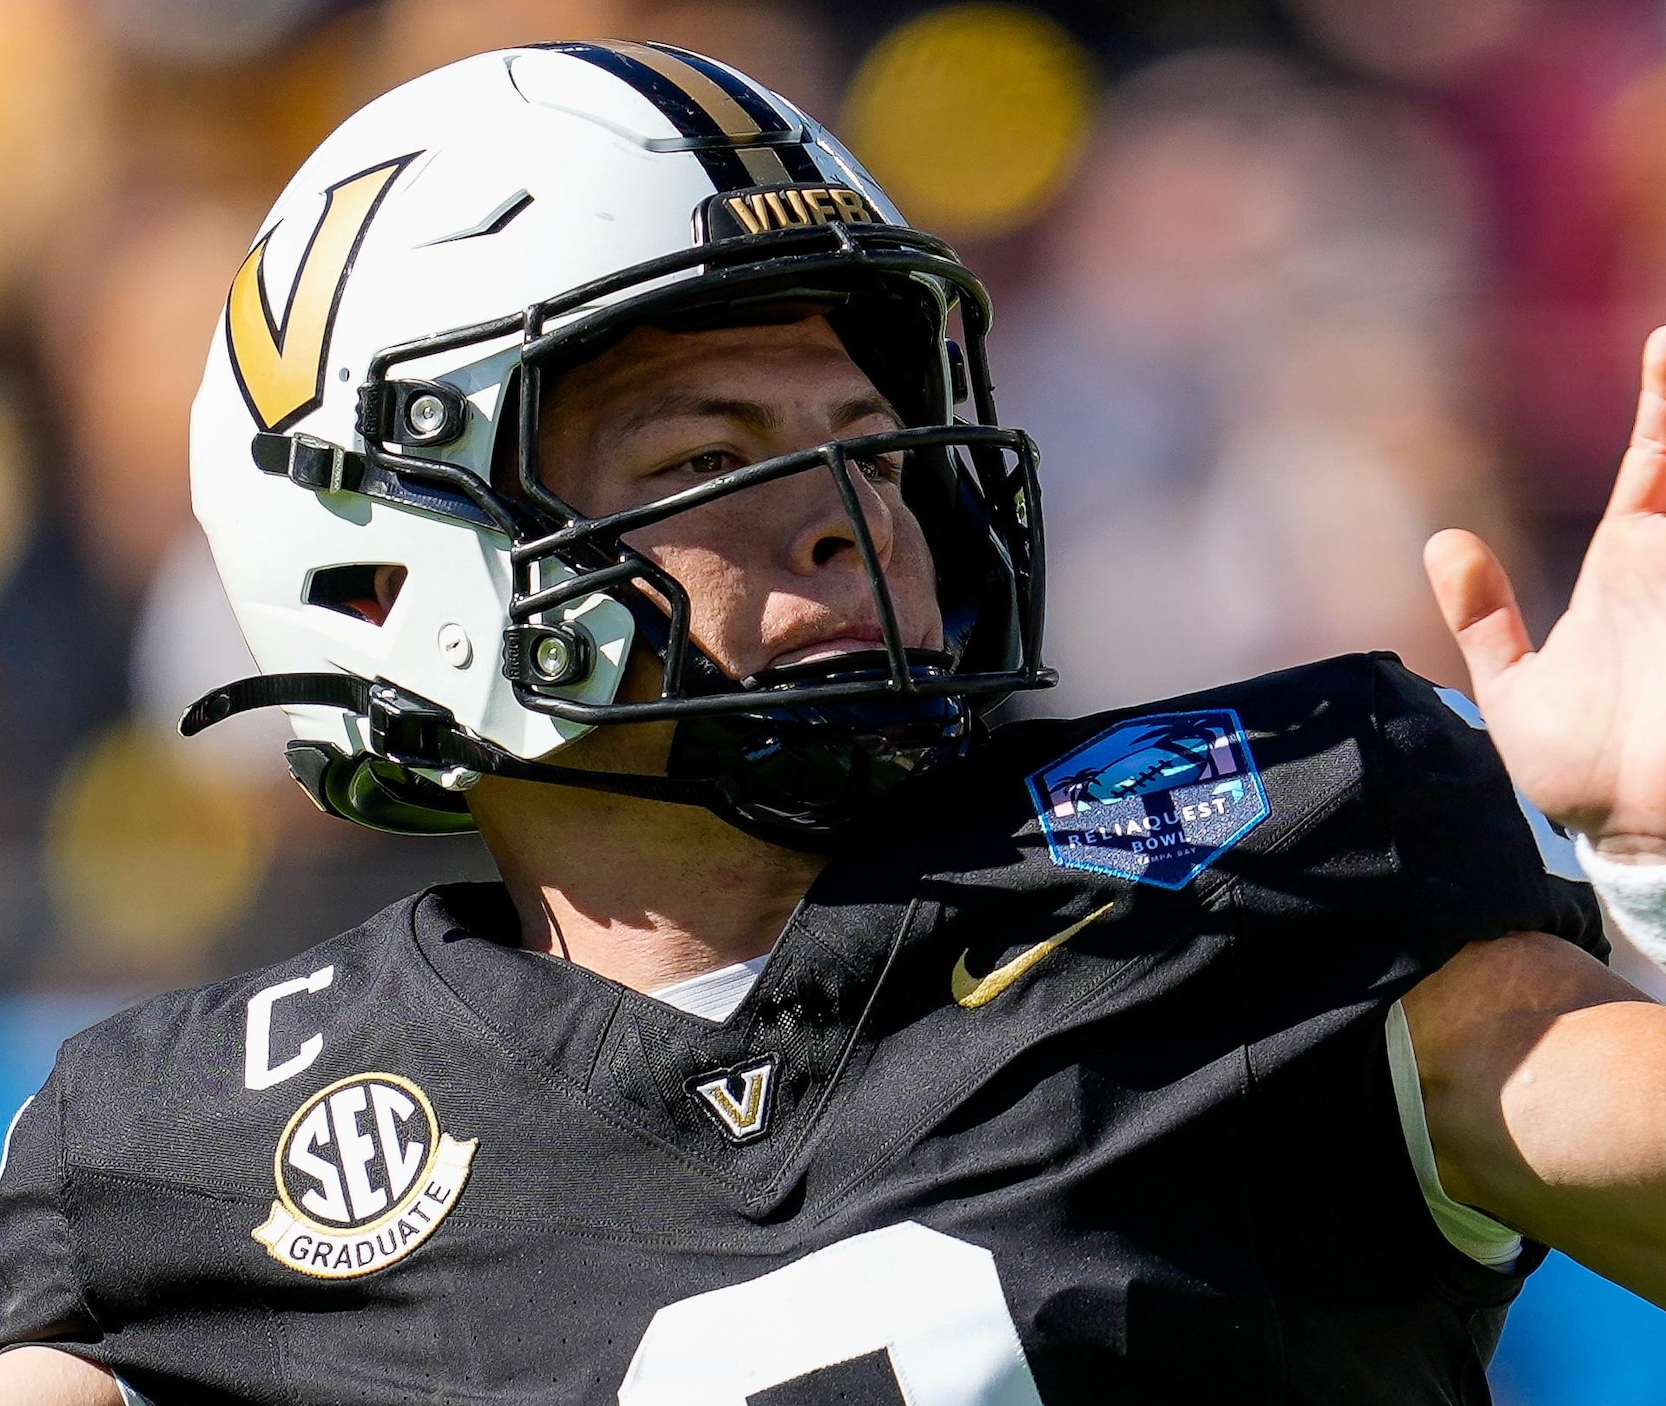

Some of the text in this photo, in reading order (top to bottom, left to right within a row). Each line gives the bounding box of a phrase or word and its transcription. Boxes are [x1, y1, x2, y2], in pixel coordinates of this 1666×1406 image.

[723, 188, 872, 235] VUFB
[225, 149, 426, 432] V
[1068, 797, 1227, 849] RELIAQUEST
[1131, 831, 1192, 853] BOWL
[244, 964, 334, 1091] C
[695, 1063, 772, 1138] V
[288, 1083, 425, 1223] SEC
[288, 1180, 452, 1270] GRADUATE
